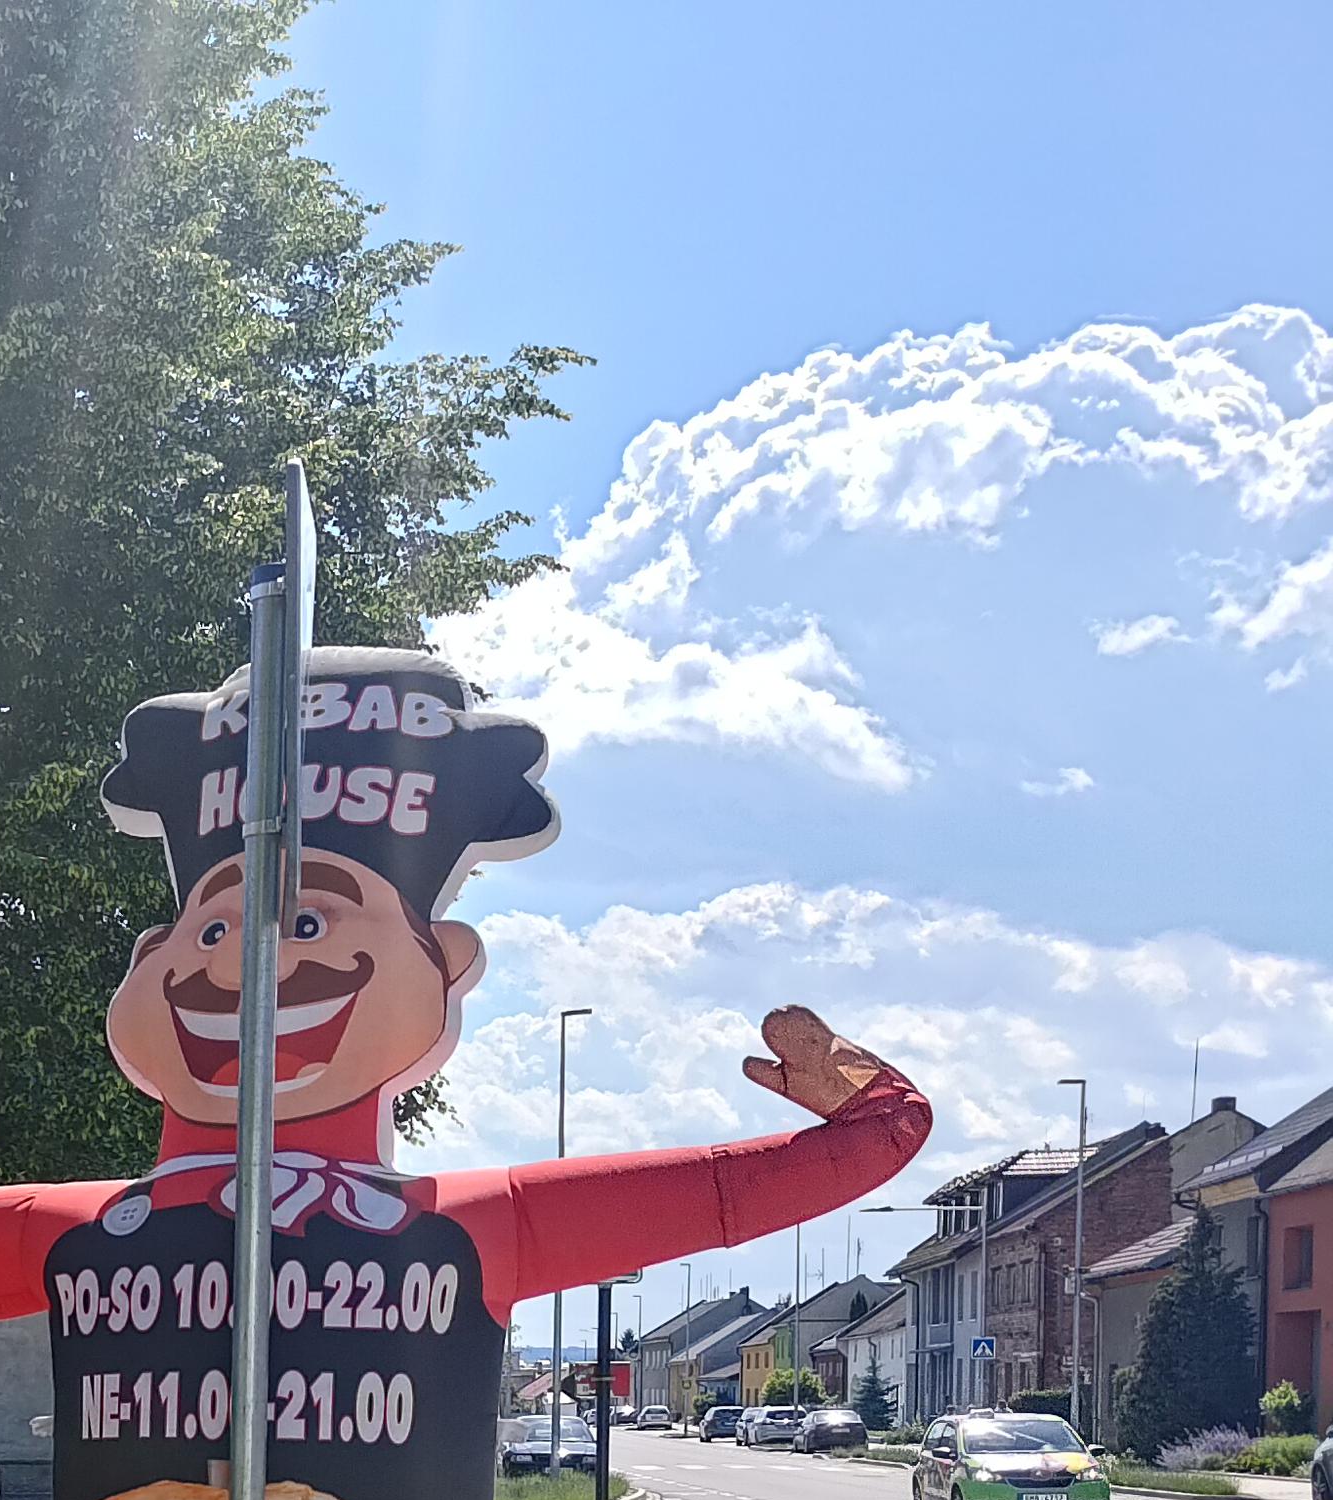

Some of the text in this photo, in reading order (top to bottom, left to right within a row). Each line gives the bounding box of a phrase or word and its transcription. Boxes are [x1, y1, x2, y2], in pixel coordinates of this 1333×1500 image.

[201, 682, 454, 742] KBAB
[198, 763, 436, 839] HUSE
[54, 1259, 459, 1337] PO-SO 100-22.00
[81, 1369, 415, 1445] NE-11.0-21.00
